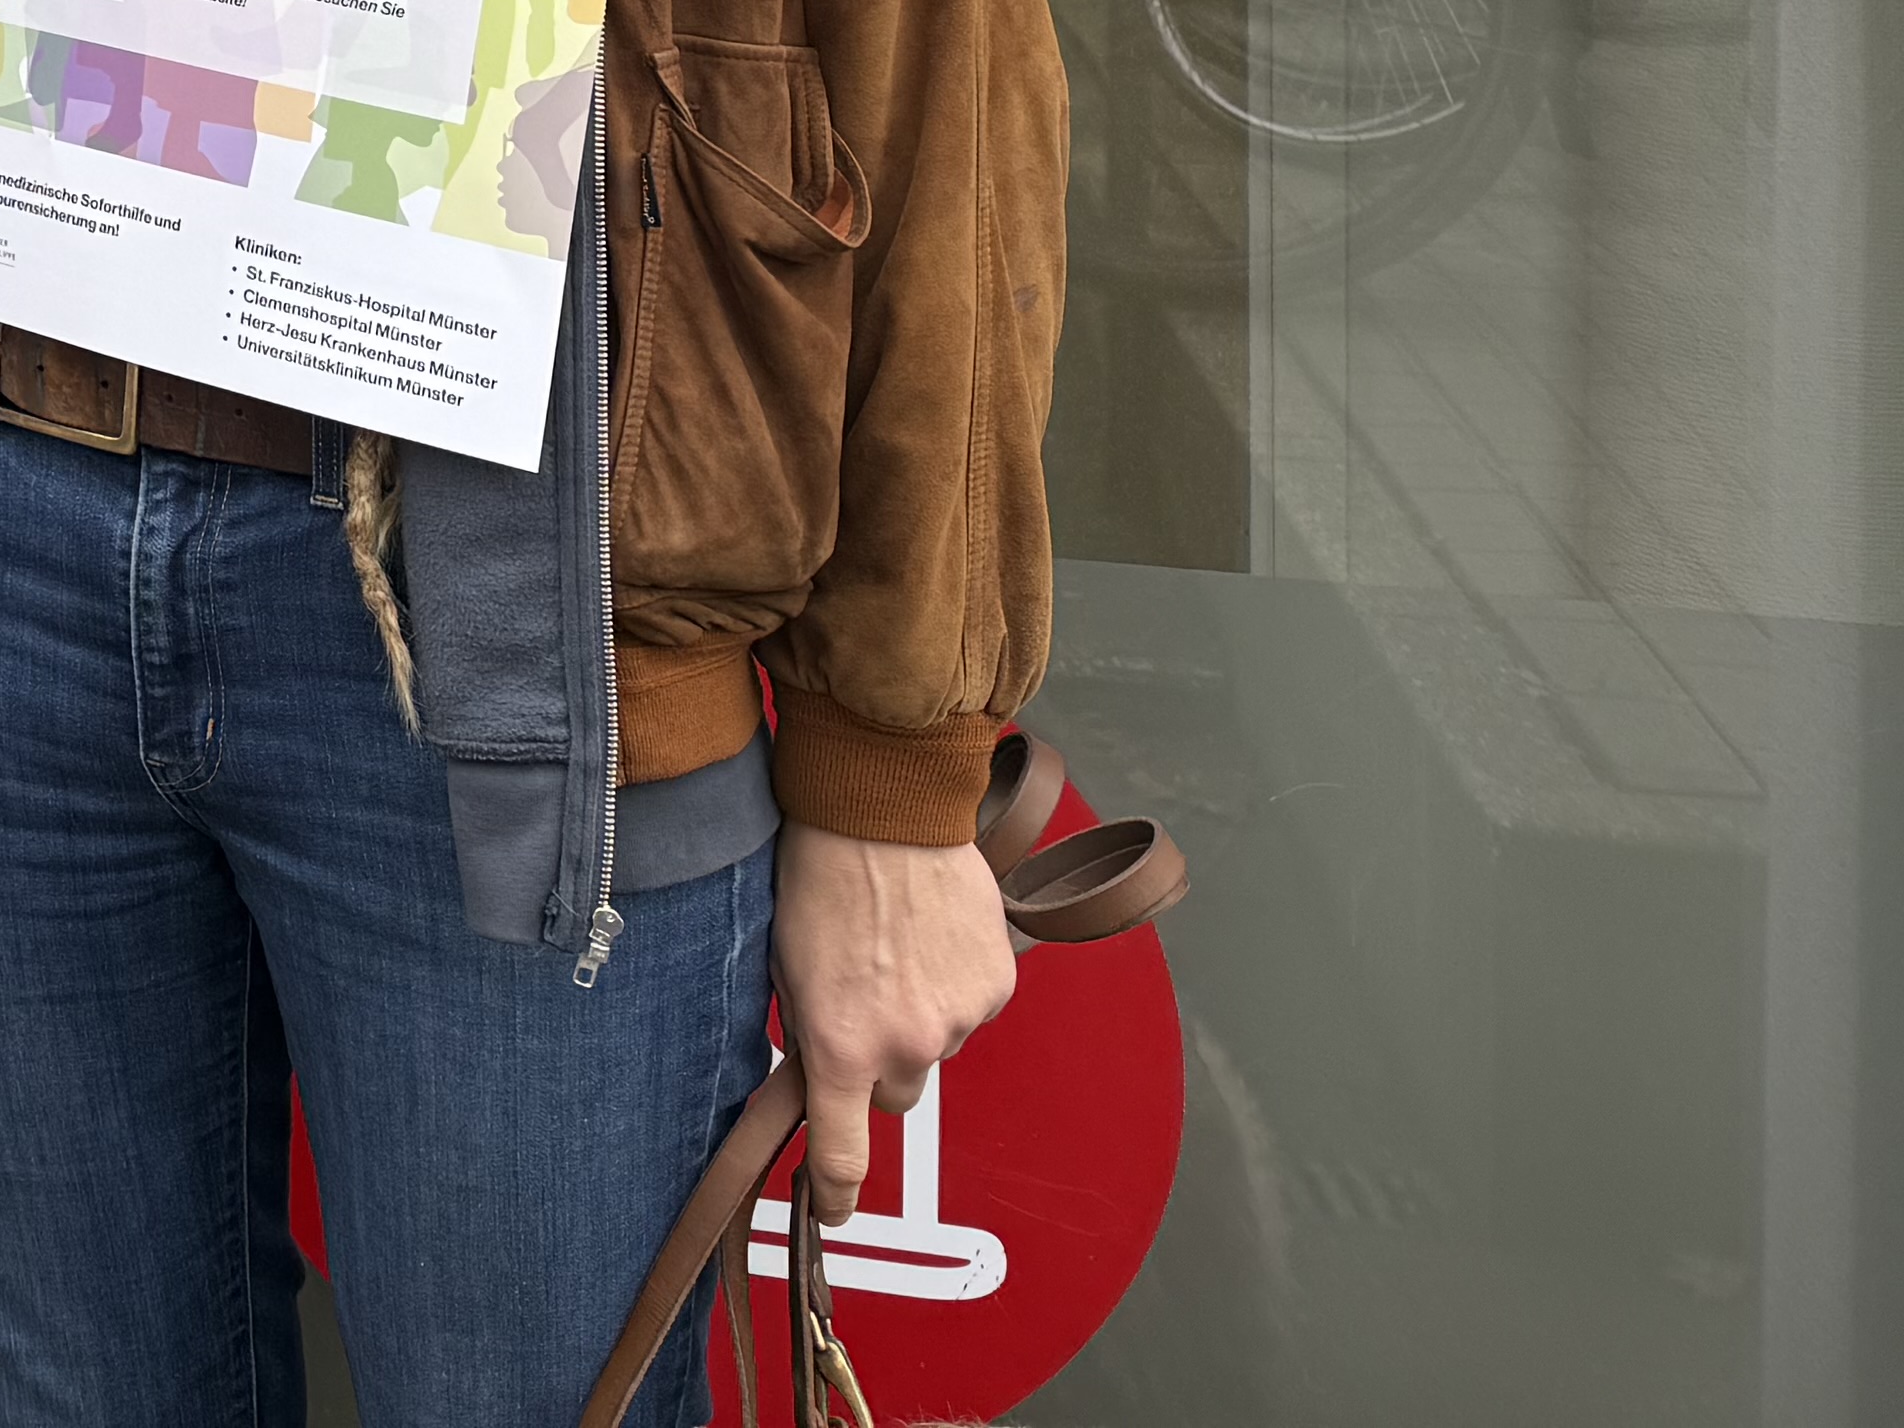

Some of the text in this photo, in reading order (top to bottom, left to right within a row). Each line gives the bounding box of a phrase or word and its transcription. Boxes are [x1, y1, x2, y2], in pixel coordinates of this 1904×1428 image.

[380, 1, 405, 19] Sie
[80, 193, 152, 224] Soforthilfe
[154, 216, 182, 232] und
[98, 222, 120, 237] an!
[234, 235, 302, 265] Kliniken:
[243, 288, 442, 352] Clemenshospital Münster
[246, 265, 498, 340] St. Franziskus-Hospital Münster
[237, 334, 465, 407] Universitätsklinikum Münster
[240, 311, 498, 390] Herz-Jesu Krankenhaus Münster
